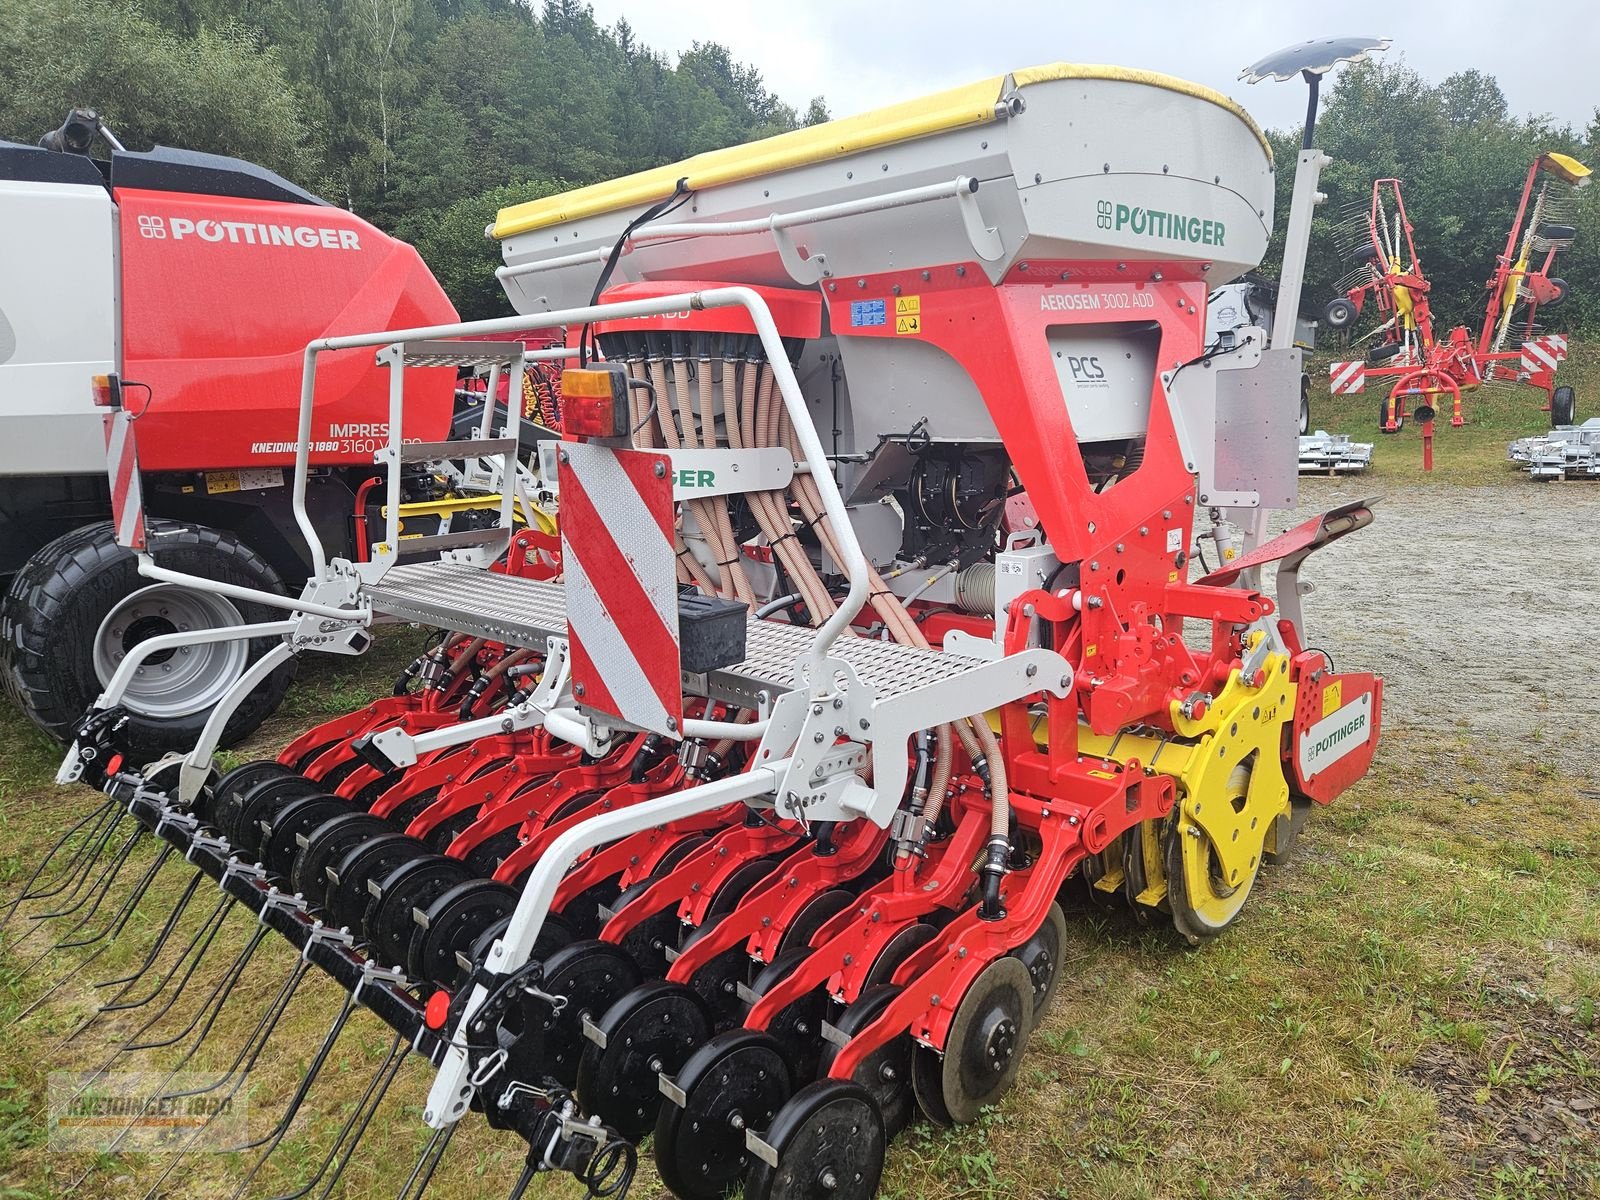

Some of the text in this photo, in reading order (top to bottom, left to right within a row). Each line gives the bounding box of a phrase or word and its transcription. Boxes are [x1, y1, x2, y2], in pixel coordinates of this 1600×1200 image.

[1041, 293, 1154, 311] AEROSEM 3002 ADD
[1067, 356, 1105, 379] PCS
[315, 441, 339, 452] 1880
[340, 439, 375, 454] 3160
